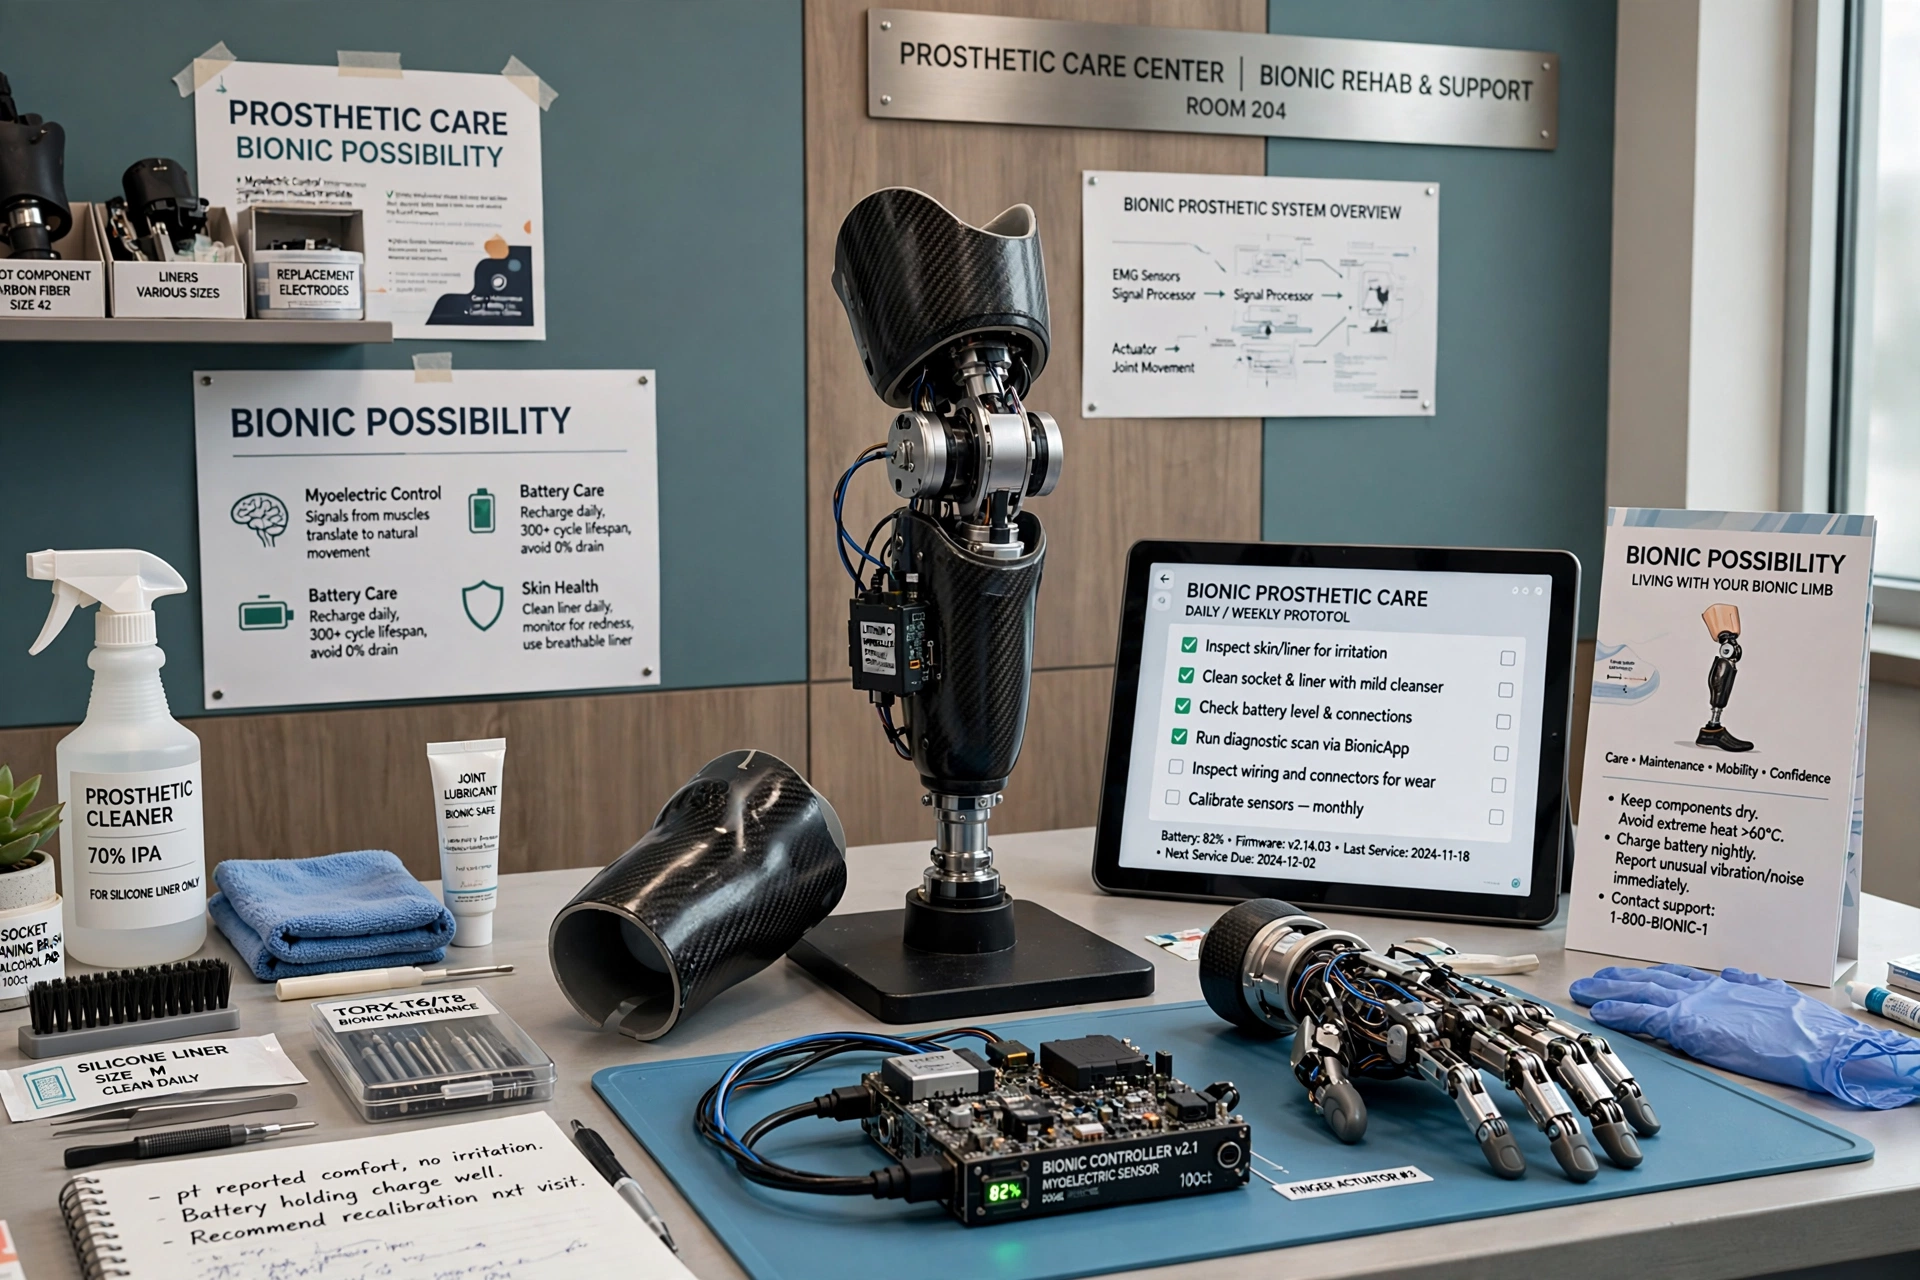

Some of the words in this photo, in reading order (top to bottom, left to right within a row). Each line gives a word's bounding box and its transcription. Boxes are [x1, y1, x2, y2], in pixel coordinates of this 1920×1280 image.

[900, 41, 1057, 75] PROSTHETIC
[1062, 50, 1127, 79] CARE
[1133, 56, 1225, 86] CENTER
[1260, 63, 1335, 90] BIONIC
[1342, 69, 1412, 94] REHAB
[1439, 75, 1536, 104] SUPPORT
[230, 99, 421, 132] PROSTHETIC
[430, 108, 508, 136] CARE
[1186, 96, 1246, 118] ROOM
[1252, 100, 1286, 119] 204
[237, 136, 333, 162] BIONIC
[342, 140, 503, 168] POSSIBILITY
[1124, 196, 1174, 213] BIONIC
[1178, 198, 1268, 216] PROSTHETIC
[1272, 201, 1326, 217] SYSTEM
[1330, 204, 1402, 220] OVERVIEW
[159, 271, 198, 283] LINERS
[276, 268, 354, 281] REPLACEMENT
[1113, 268, 1139, 281] EMG
[1141, 269, 1181, 282] Sensors
[136, 286, 188, 298] VARIOUS
[190, 287, 220, 299] SIZES
[279, 284, 349, 296] ELECTRODES
[1112, 287, 1144, 303] Signal
[1146, 288, 1196, 301] Processor
[10, 299, 35, 310] SIZE
[37, 300, 52, 310] 42
[1112, 342, 1157, 355] Actuator
[1112, 361, 1138, 373] Joint
[1141, 361, 1195, 374] Movement
[230, 407, 356, 438] BIONIC
[367, 406, 571, 436] POSSIBILITY
[305, 487, 387, 506] Myoelectric
[390, 485, 441, 501] Control
[520, 484, 570, 500] Battery
[573, 483, 604, 498] Care
[306, 508, 349, 526] Signals
[352, 508, 380, 522] from
[383, 507, 430, 521] muscles
[520, 505, 574, 521] Recharge
[576, 504, 605, 520] daily,
[306, 525, 358, 542] translate
[362, 528, 374, 540] to
[378, 526, 418, 539] natural
[520, 524, 550, 536] 300+
[553, 522, 582, 539] cycle
[585, 521, 632, 537] lifespan,
[307, 546, 370, 559] movement
[520, 541, 552, 554] avoid
[554, 540, 573, 554] 0%
[576, 540, 604, 553] drain
[1626, 545, 1701, 567] BIONIC
[1708, 548, 1846, 574] POSSIBILITY
[522, 580, 551, 596] Skin
[555, 578, 599, 594] Health
[1187, 582, 1251, 600] BIONIC
[1256, 584, 1372, 605] PROSTHETIC
[1377, 589, 1428, 607] CARE
[1632, 574, 1674, 588] LIVING
[1676, 576, 1710, 590] WITH
[1712, 578, 1749, 592] YOUR
[1752, 580, 1798, 594] BIONIC
[1801, 582, 1834, 596] LIMB
[522, 602, 554, 615] Clean
[558, 601, 582, 614] liner
[584, 600, 613, 616] daily,
[1185, 604, 1220, 618] DAILY
[1232, 607, 1281, 620] WEEKLY
[1206, 639, 1251, 657] Inspect
[1253, 640, 1311, 656] skin/liner
[1314, 642, 1332, 657] for
[1335, 644, 1388, 659] irritation
[1196, 730, 1220, 745] Run
[1223, 731, 1288, 751] diagnostic
[1290, 739, 1319, 750] scan
[1322, 737, 1341, 752] via
[1344, 738, 1410, 759] BionicApp
[458, 772, 486, 784] JOINT
[1605, 751, 1629, 765] Care
[1639, 754, 1705, 772] Maintenance
[1716, 762, 1759, 780] Mobility
[1770, 767, 1831, 784] Confidence
[86, 780, 193, 806] PROSTHETIC
[444, 785, 498, 800] LUBRICANT
[445, 807, 474, 820] BIONIC
[476, 806, 495, 816] SAFE
[1188, 792, 1244, 808] Calibrate
[1247, 798, 1294, 811] sensors
[1312, 800, 1364, 819] monthly
[1621, 793, 1652, 812] Keep
[1655, 800, 1732, 817] components
[1735, 804, 1758, 822] dry.
[86, 806, 173, 828] CLEANER
[88, 846, 126, 864] 70%
[132, 845, 162, 864] IPA
[1161, 830, 1200, 846] Battery:
[1202, 832, 1224, 845] 82%
[1236, 835, 1286, 849] Firmware:
[1288, 839, 1331, 852] v2.14.03
[1343, 842, 1366, 855] Last
[1368, 844, 1409, 858] Service:
[1410, 847, 1470, 862] 2024-11-18
[1165, 847, 1189, 860] Next
[1192, 848, 1228, 862] Service
[1230, 851, 1254, 864] Due:
[1256, 853, 1316, 869] 2024-12-02
[89, 888, 108, 900] FOR
[110, 887, 153, 900] SILICONE
[156, 883, 180, 897] LINER
[182, 877, 200, 892] ONLY
[1613, 870, 1690, 896] immediately.
[1611, 891, 1660, 910] Contact
[1662, 900, 1715, 916] support:
[1, 922, 48, 942] SOCKET
[1610, 910, 1708, 936] 1-800-BIONIC-1
[333, 1002, 398, 1016] TORX
[400, 994, 466, 1008] T6/T8
[338, 1014, 384, 1026] BIONIC
[386, 1003, 479, 1020] MAINTENANCE
[77, 1052, 167, 1073] SILICONE
[172, 1045, 229, 1059] LINER
[95, 1071, 133, 1084] SIZE
[150, 1065, 166, 1077] M
[102, 1080, 154, 1096] CLEAN
[156, 1074, 199, 1087] DAILY
[1042, 1156, 1087, 1174] BIONIC
[1089, 1144, 1172, 1168] CONTROLLER
[1174, 1140, 1198, 1156] v2.1
[177, 1184, 200, 1205] pt
[216, 1170, 306, 1196] reported
[322, 1158, 407, 1180] comfort,
[419, 1158, 440, 1166] no
[452, 1143, 543, 1168] irritation.
[1042, 1168, 1116, 1190] MYOELECTRIC
[1118, 1162, 1160, 1180] SENSOR
[1180, 1171, 1212, 1188] 100ct
[989, 1183, 1021, 1202] 82%
[190, 1212, 326, 1245] Recommend
[342, 1192, 478, 1222] recalibration
[492, 1184, 524, 1199] nxt
[537, 1176, 585, 1192] visit.
